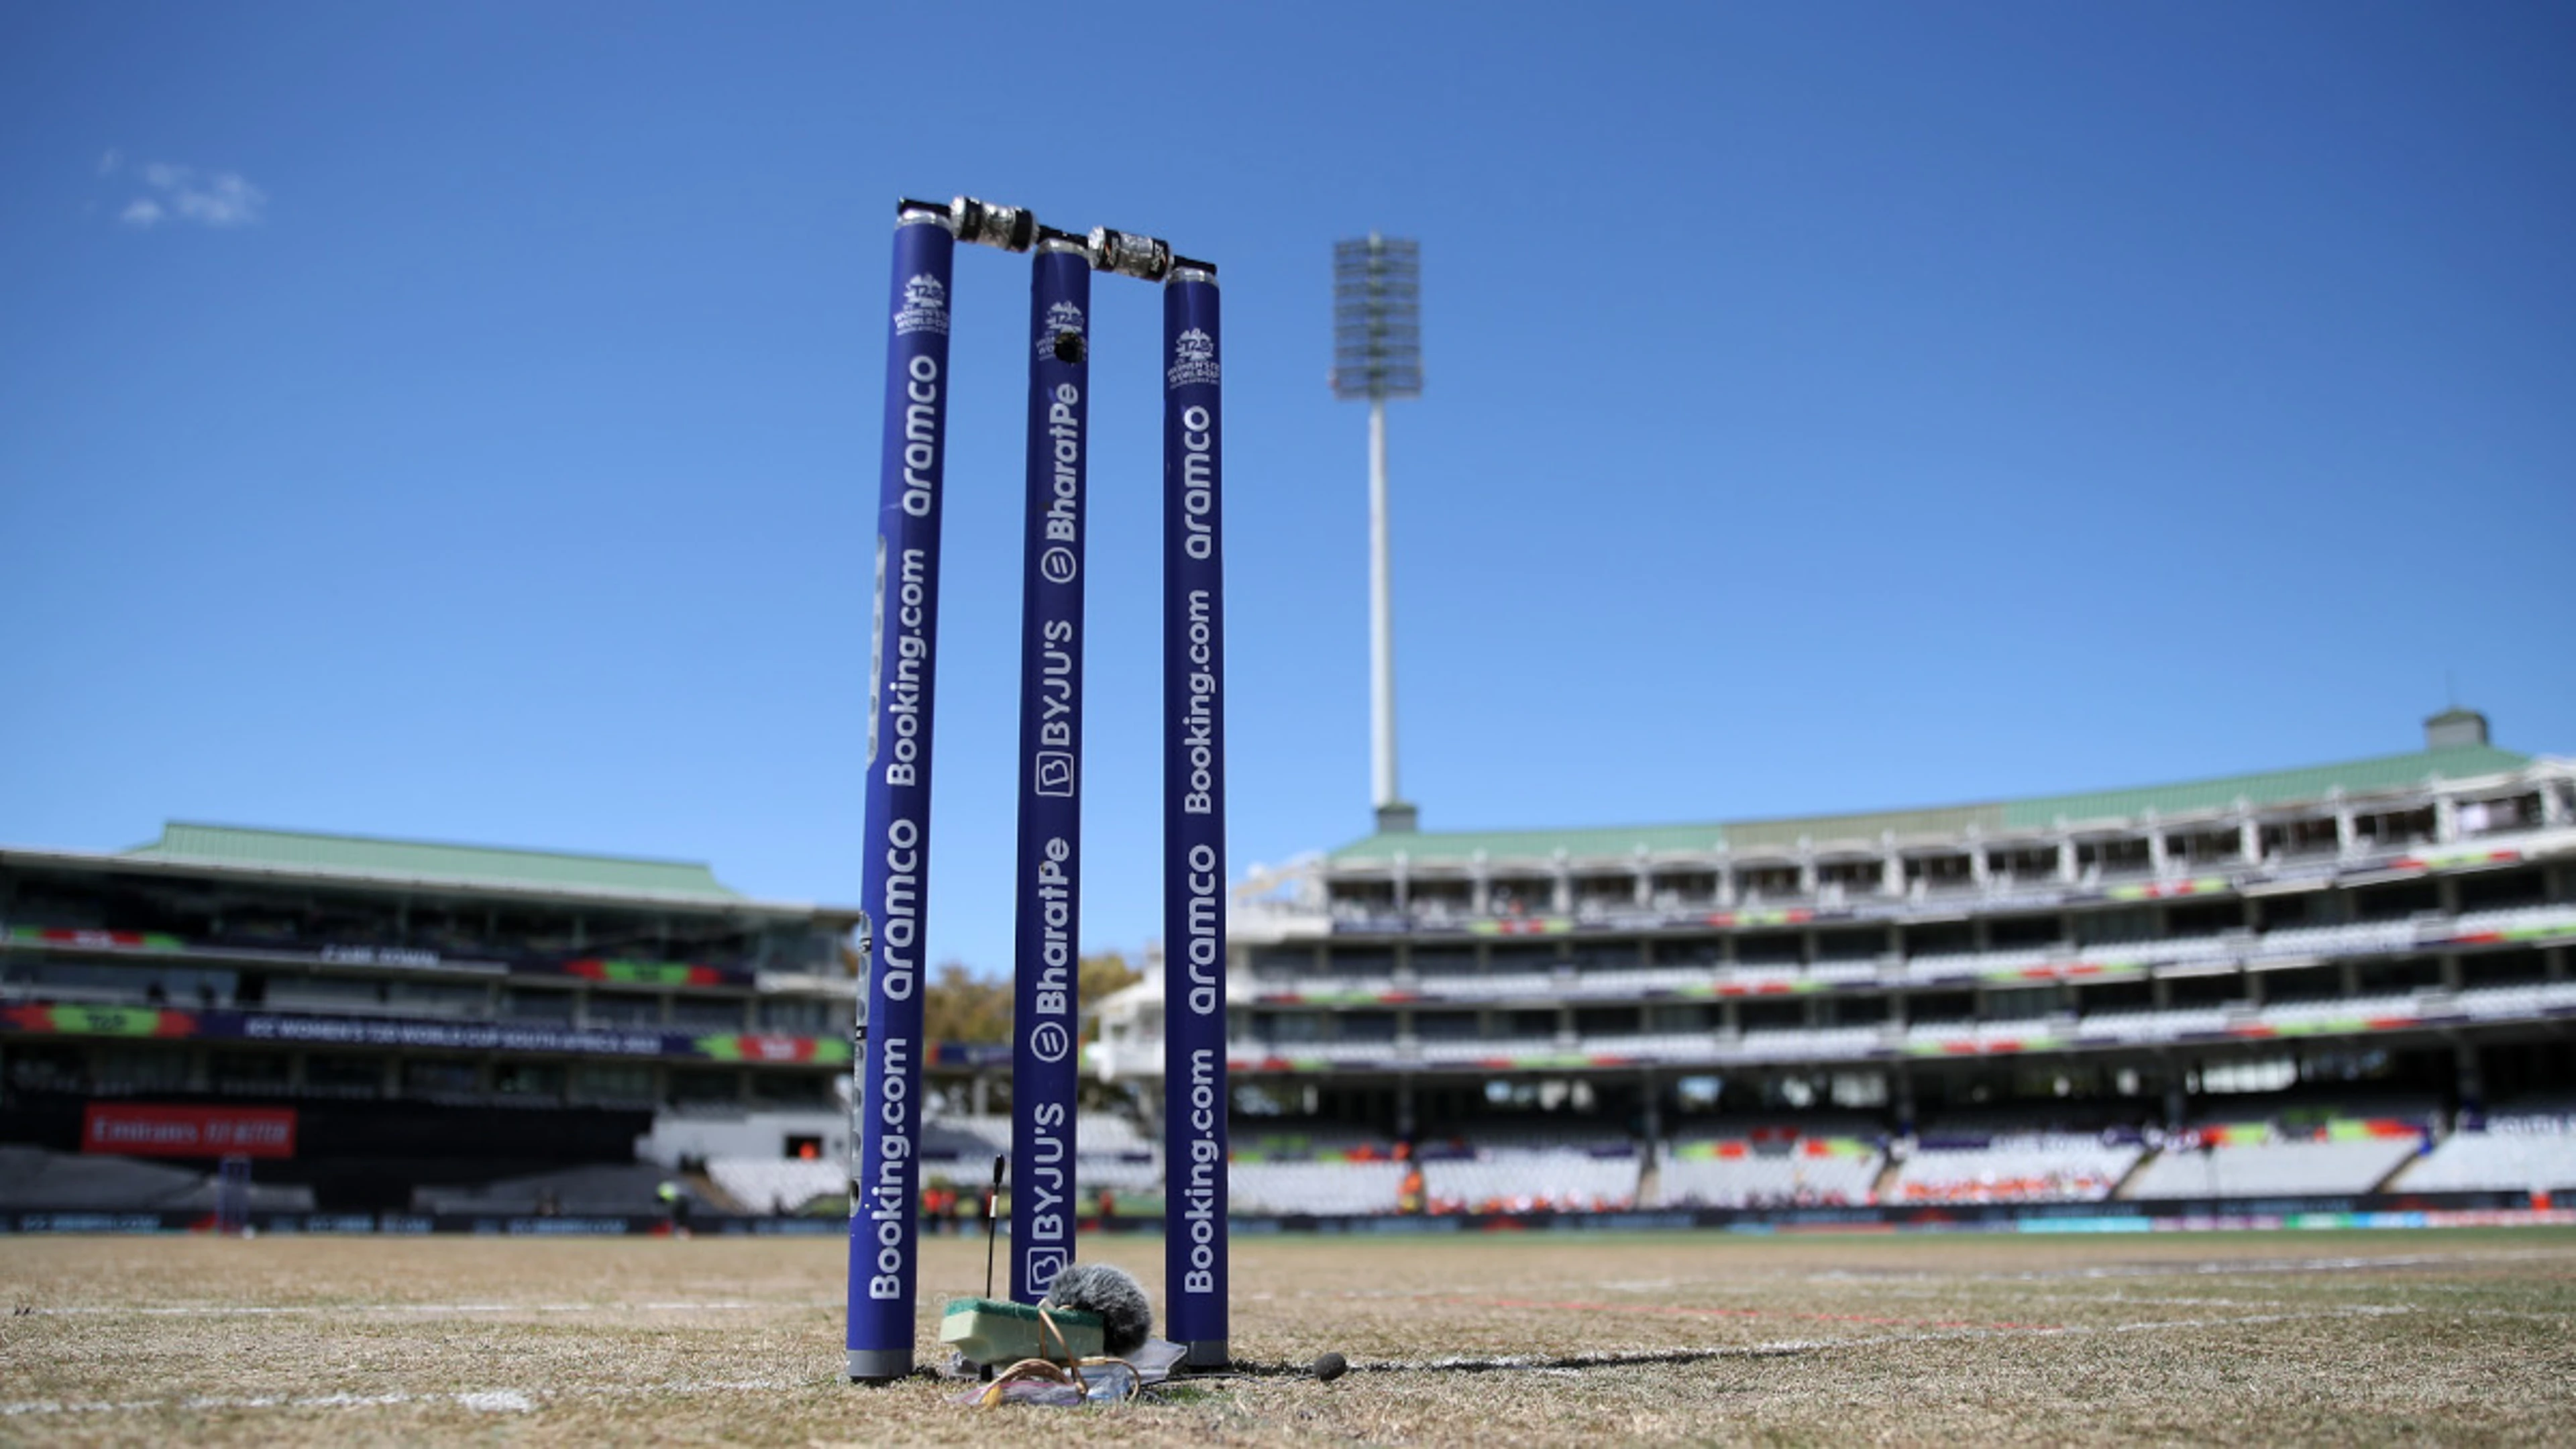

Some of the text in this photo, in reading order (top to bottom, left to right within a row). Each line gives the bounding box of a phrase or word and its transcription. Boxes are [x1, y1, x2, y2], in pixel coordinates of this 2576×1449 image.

[902, 355, 938, 517] aramco
[1046, 382, 1079, 542] BharatPe
[1183, 405, 1212, 559] aramco
[886, 548, 926, 786] Booking.com
[1041, 620, 1073, 747] BYJU'S
[1183, 590, 1216, 814] Booking.com
[881, 818, 918, 1001] aramco
[1036, 837, 1070, 1015] BharatPe
[1188, 844, 1216, 1015] aramco
[870, 1038, 910, 1300] Booking.com
[1032, 1102, 1065, 1240] BYJU'S
[1185, 1049, 1219, 1293] Booking.com
